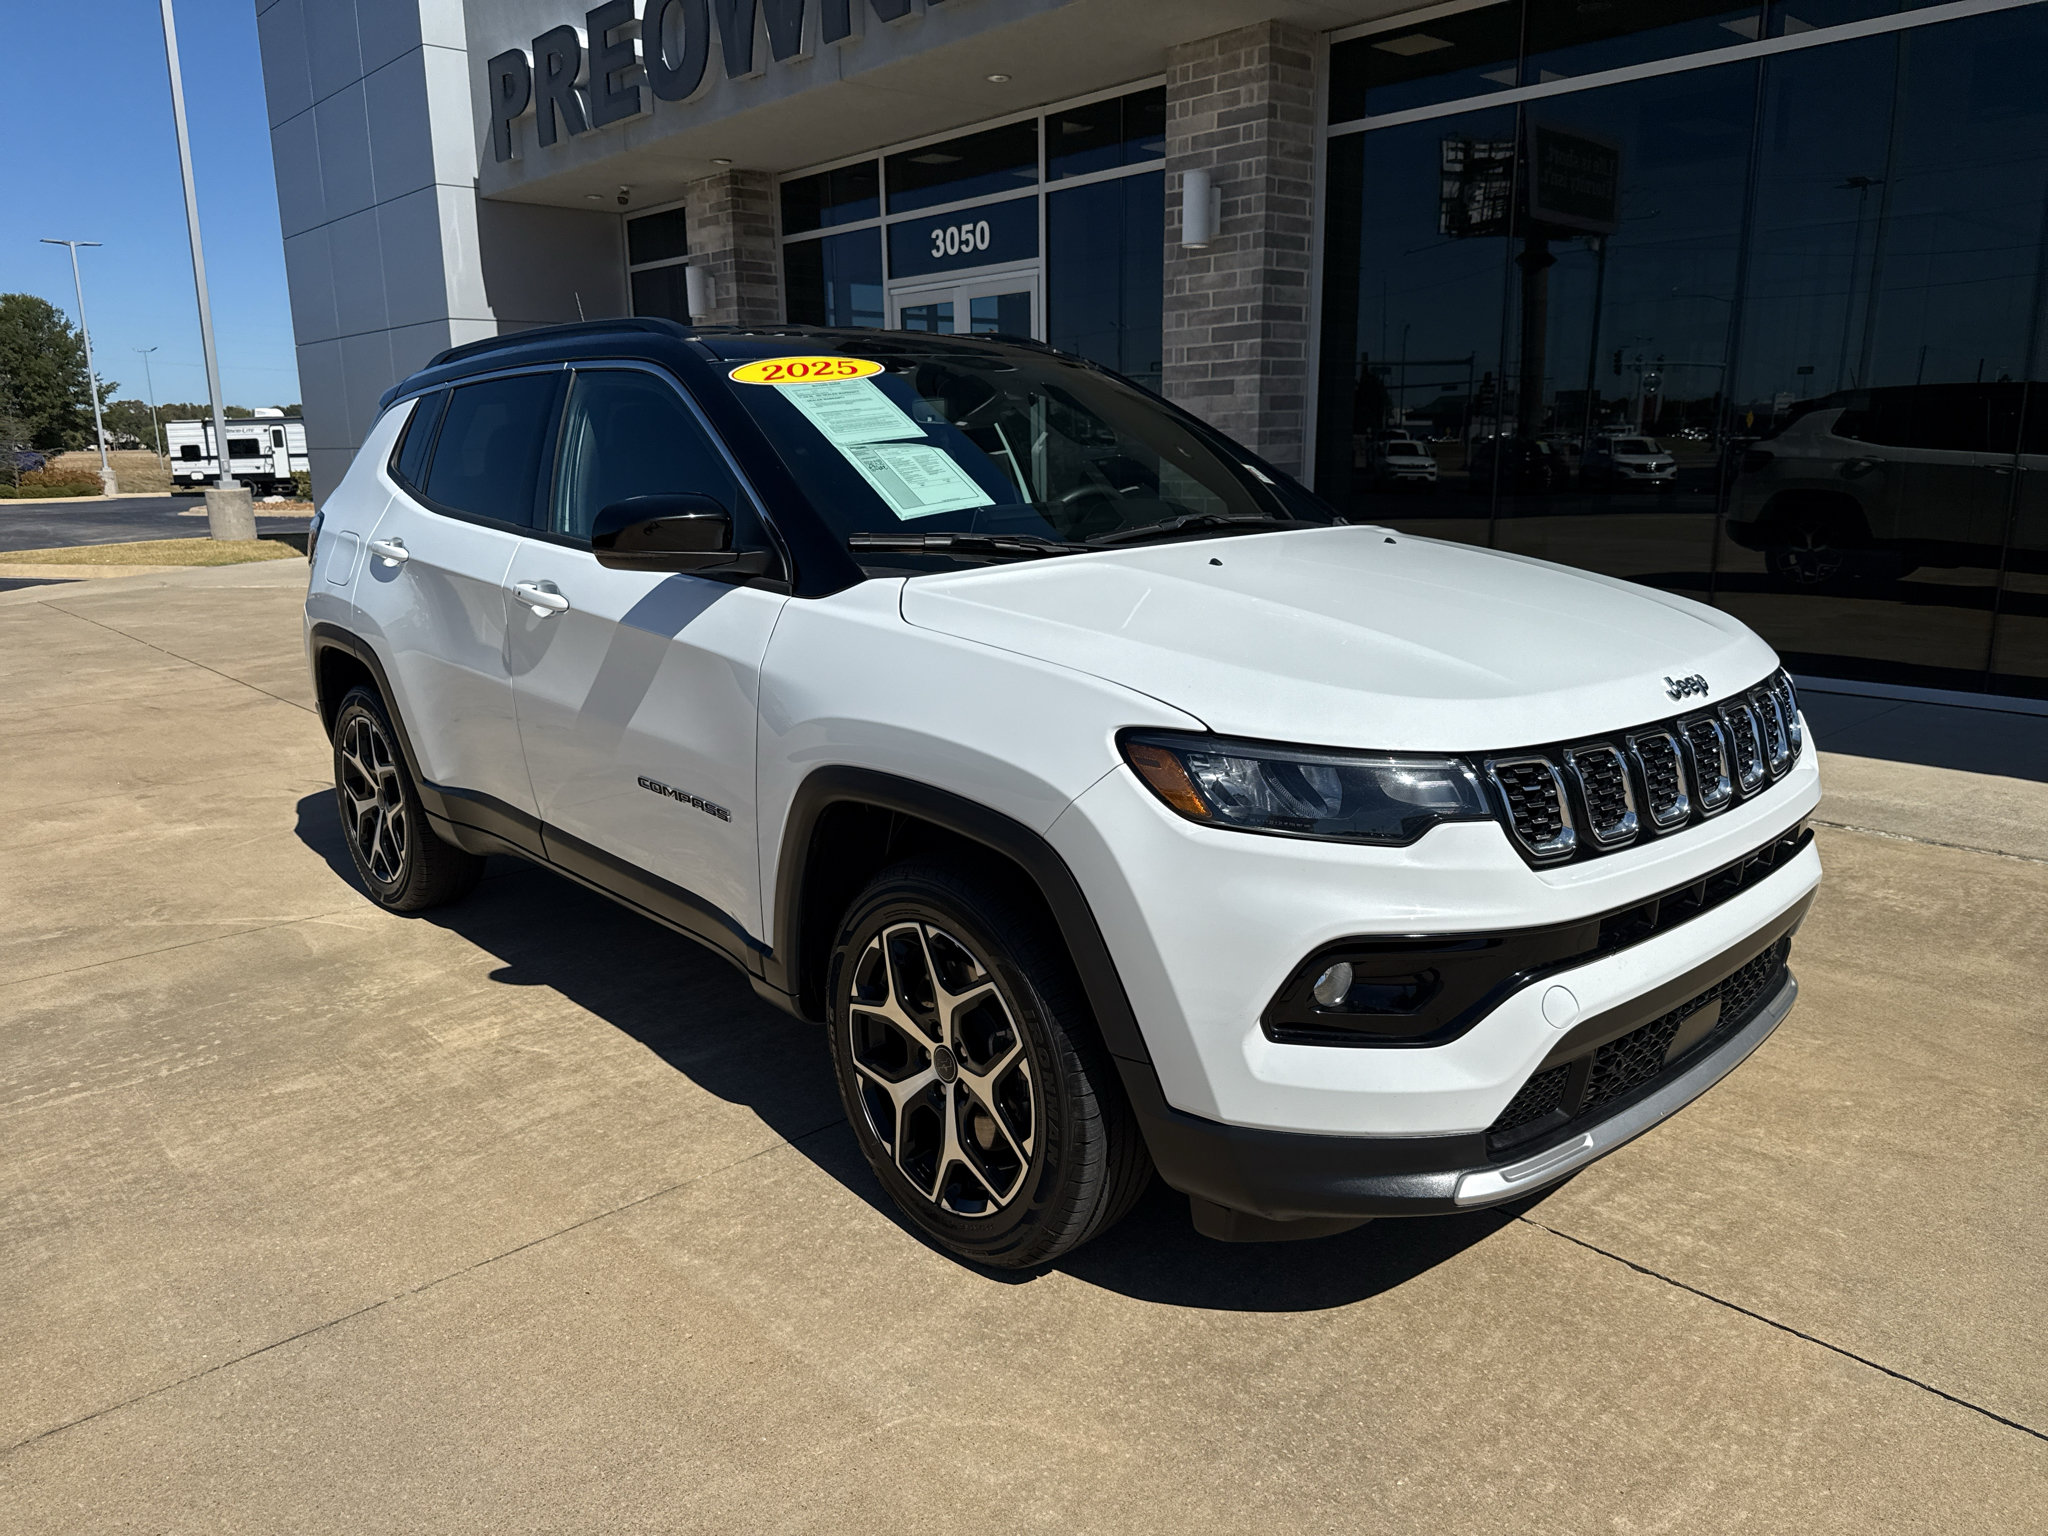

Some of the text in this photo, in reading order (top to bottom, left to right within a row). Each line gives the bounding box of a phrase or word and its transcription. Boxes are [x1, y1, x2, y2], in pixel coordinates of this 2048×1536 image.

[930, 220, 990, 258] 3050
[761, 361, 858, 381] 2025
[1664, 674, 1709, 702] Jeep
[637, 775, 731, 823] COMPASS
[1023, 1008, 1060, 1168] IRONMAN
